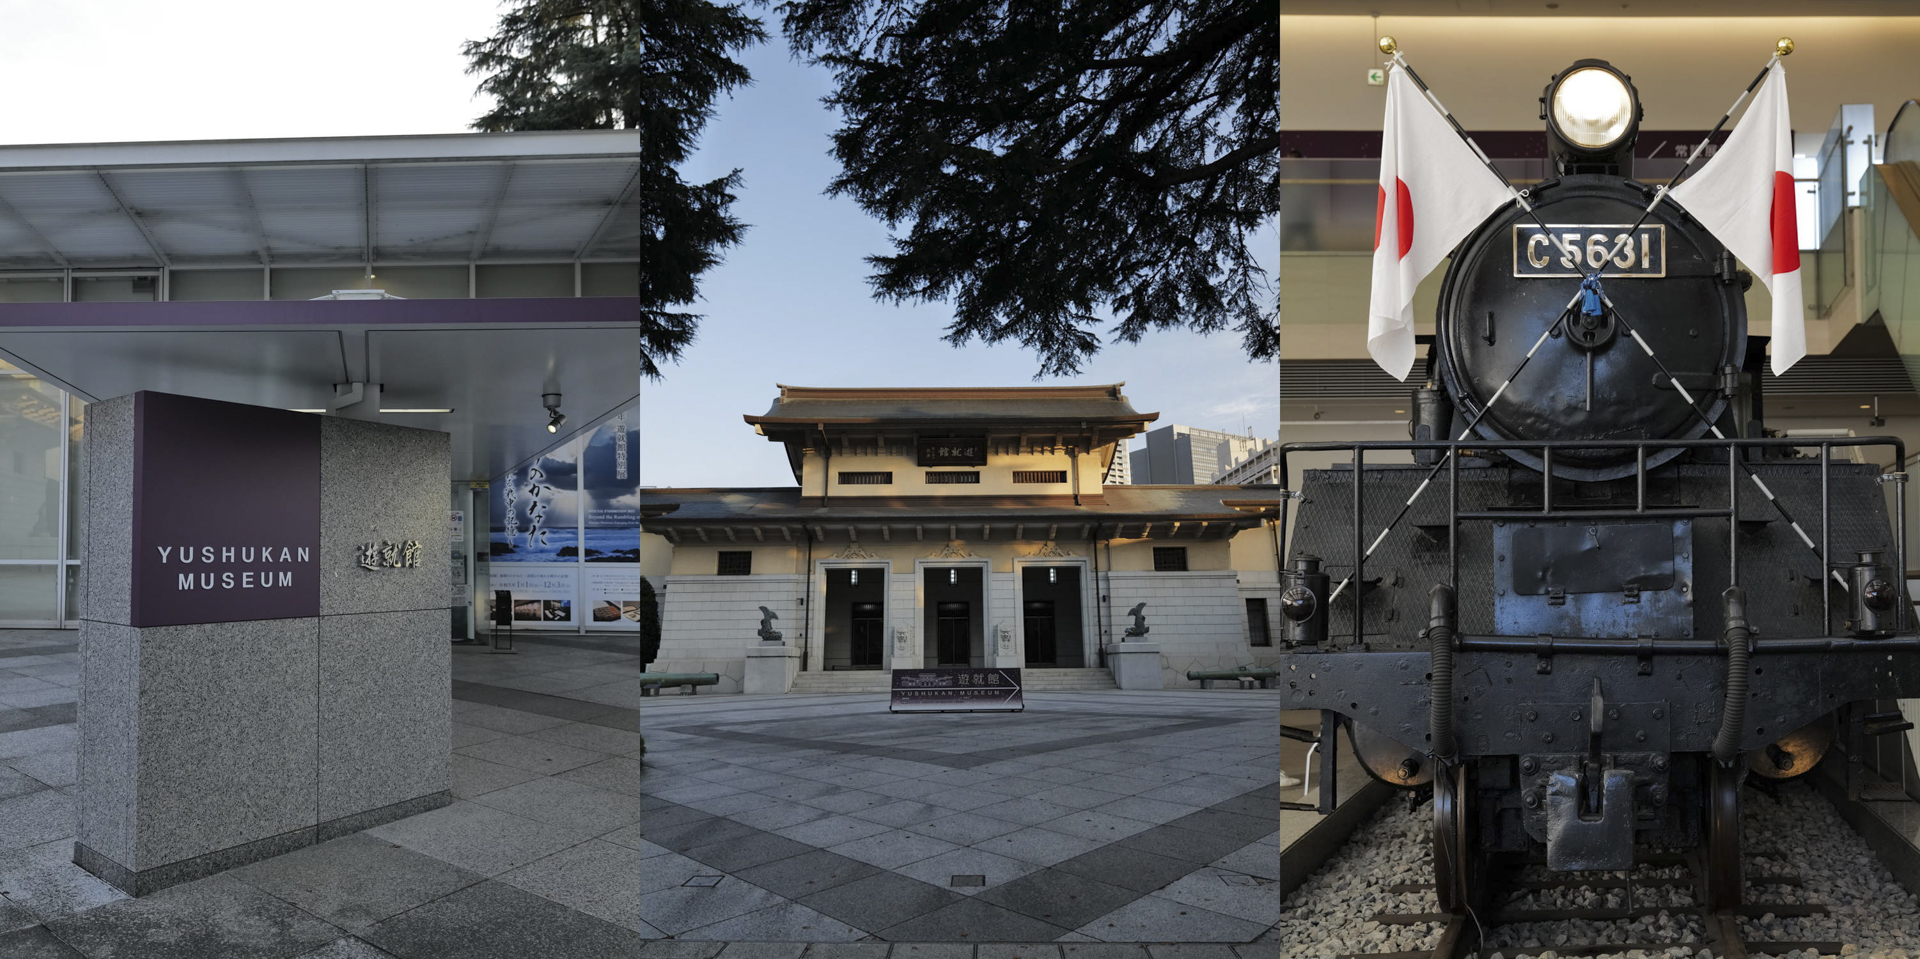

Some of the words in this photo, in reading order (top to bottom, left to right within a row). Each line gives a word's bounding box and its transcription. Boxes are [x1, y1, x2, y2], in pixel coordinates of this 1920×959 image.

[157, 546, 310, 564] YUSHUKAN
[356, 540, 422, 571] 遊就館
[178, 571, 293, 590] MUSEUM
[958, 673, 1000, 685] 遊就館
